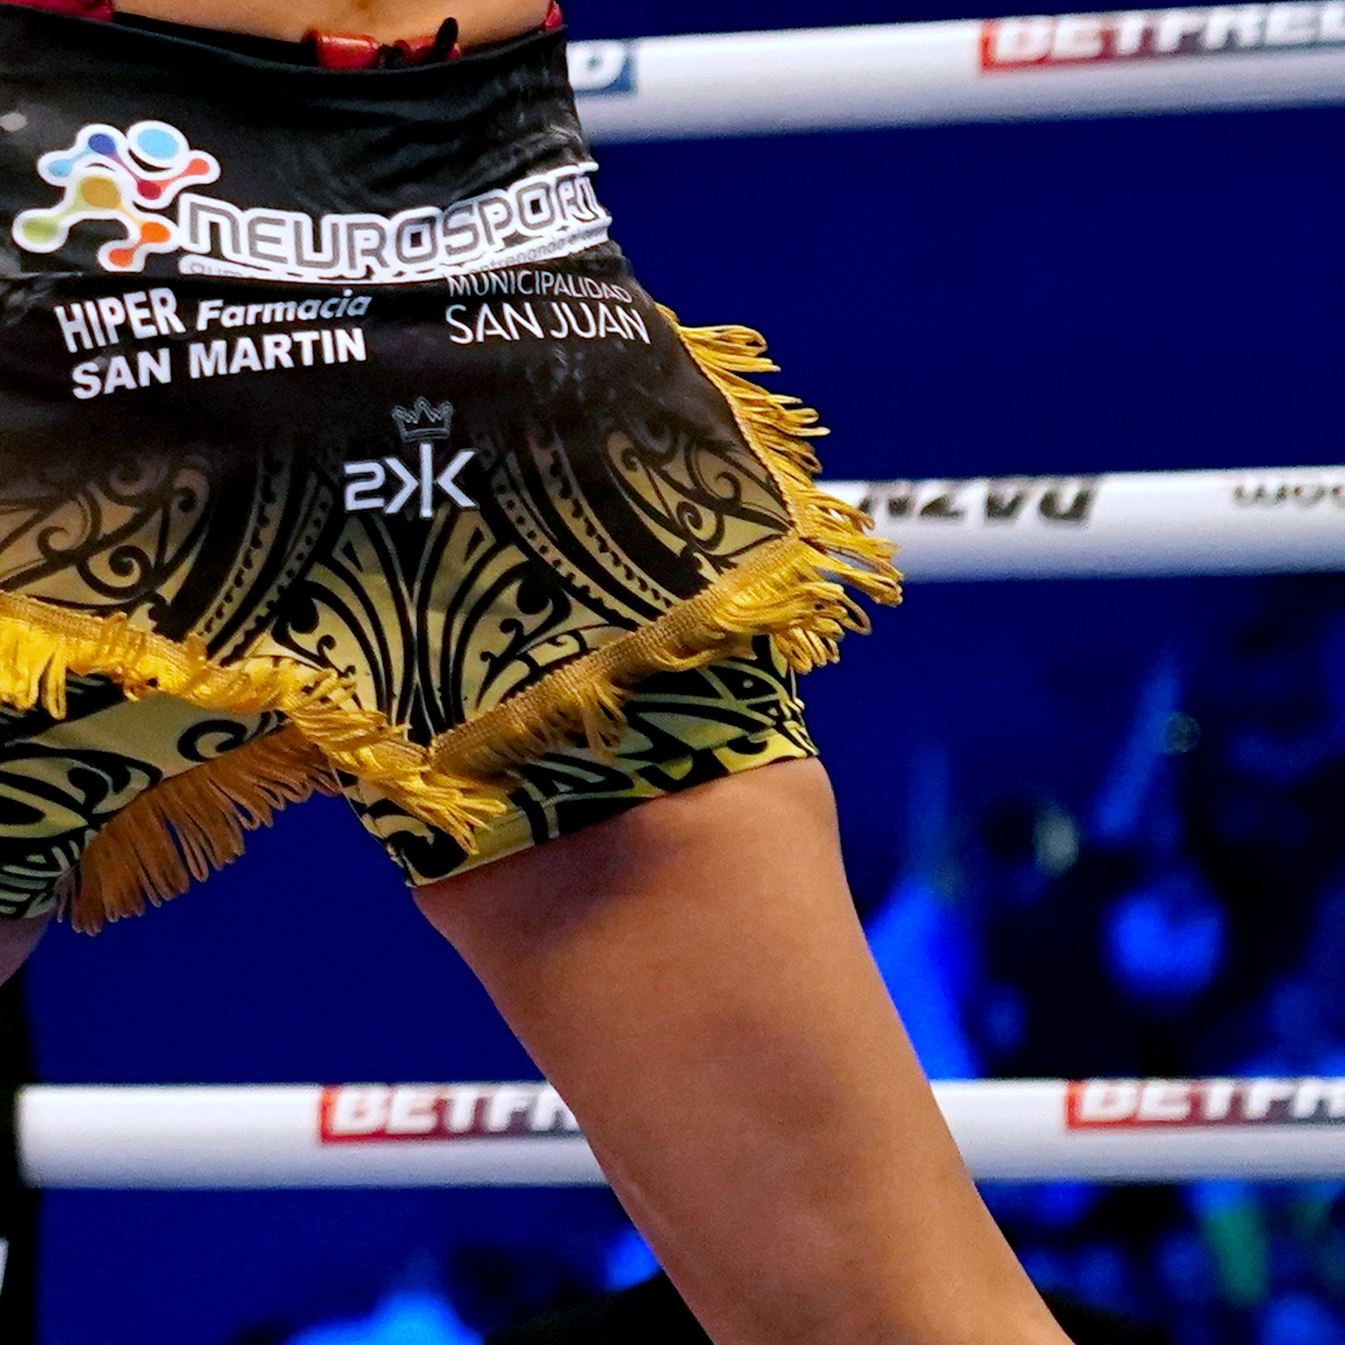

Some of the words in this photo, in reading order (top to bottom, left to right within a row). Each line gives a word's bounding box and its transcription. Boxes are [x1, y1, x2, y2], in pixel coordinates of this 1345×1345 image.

[181, 170, 605, 273] NEUROSPORT
[447, 268, 631, 303] MUNICIPALIDAD
[54, 287, 187, 353] HIPER
[196, 289, 373, 332] Farmacia
[446, 301, 545, 345] SAN
[549, 301, 651, 345] JUAN
[71, 347, 172, 400] SAN
[188, 327, 367, 379] MARTIN
[330, 1084, 581, 1138] BETFR
[1080, 1078, 1345, 1123] BETFR
